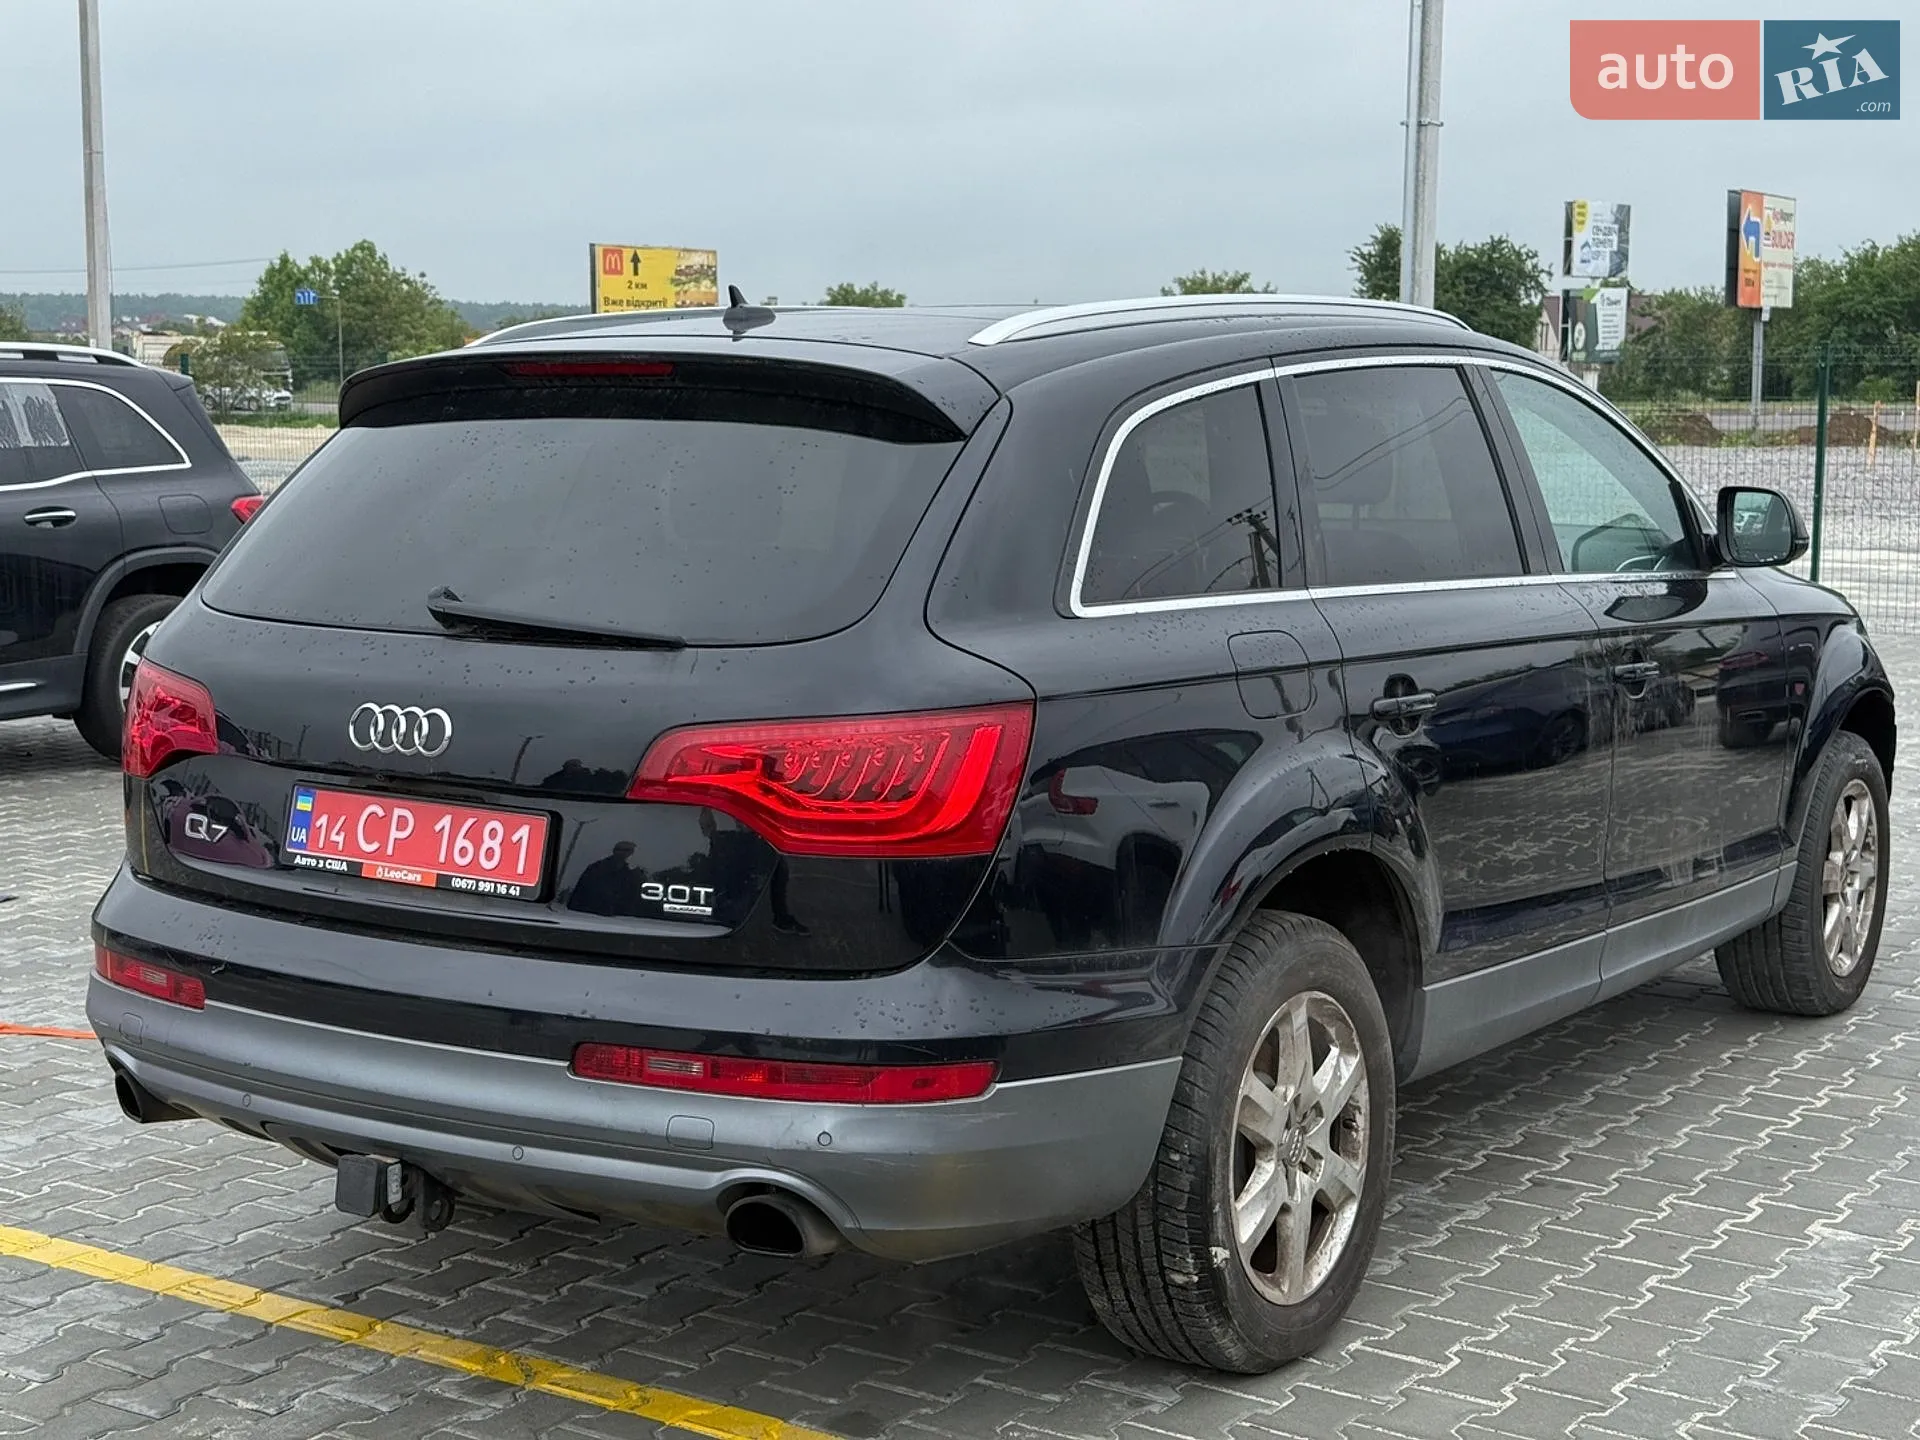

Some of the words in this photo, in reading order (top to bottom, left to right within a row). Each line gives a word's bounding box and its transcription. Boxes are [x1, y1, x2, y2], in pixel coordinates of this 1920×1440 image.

[627, 280, 633, 290] 2
[603, 296, 624, 307] Вже
[185, 812, 229, 843] Q7
[291, 826, 307, 843] UA
[315, 813, 348, 851] 14
[357, 803, 415, 856] CP
[433, 814, 531, 875] 1681
[294, 855, 317, 867] Авто
[325, 858, 348, 871] США
[384, 867, 421, 882] LeoCars
[451, 877, 476, 890] (067)
[478, 881, 494, 893] 991
[496, 884, 507, 894] 16
[508, 886, 520, 896] 41
[641, 882, 714, 905] 3.0T
